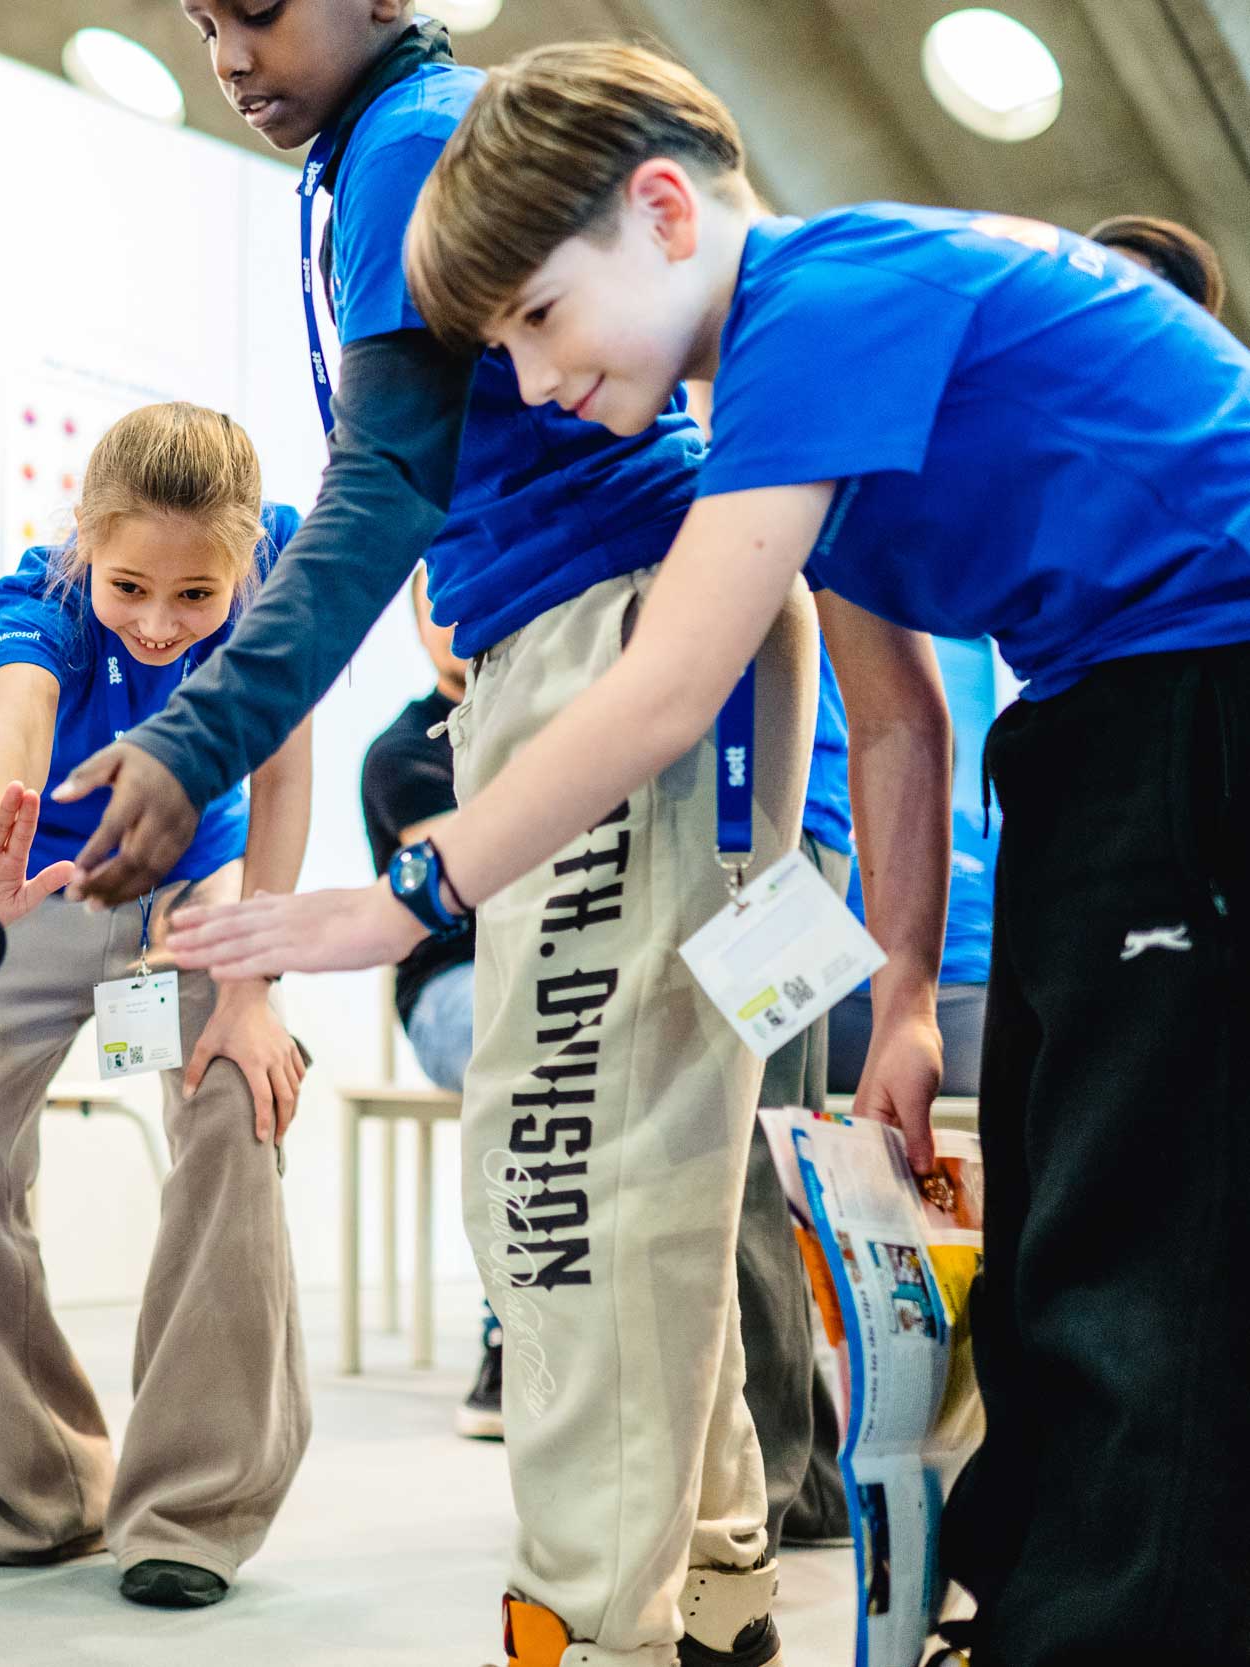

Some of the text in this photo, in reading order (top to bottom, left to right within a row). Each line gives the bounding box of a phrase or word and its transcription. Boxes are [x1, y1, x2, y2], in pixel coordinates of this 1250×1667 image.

[304, 160, 324, 197] sett
[311, 350, 327, 385] sett
[107, 655, 123, 685] sett
[725, 746, 746, 787] sett
[505, 967, 618, 1293] DIVISION
